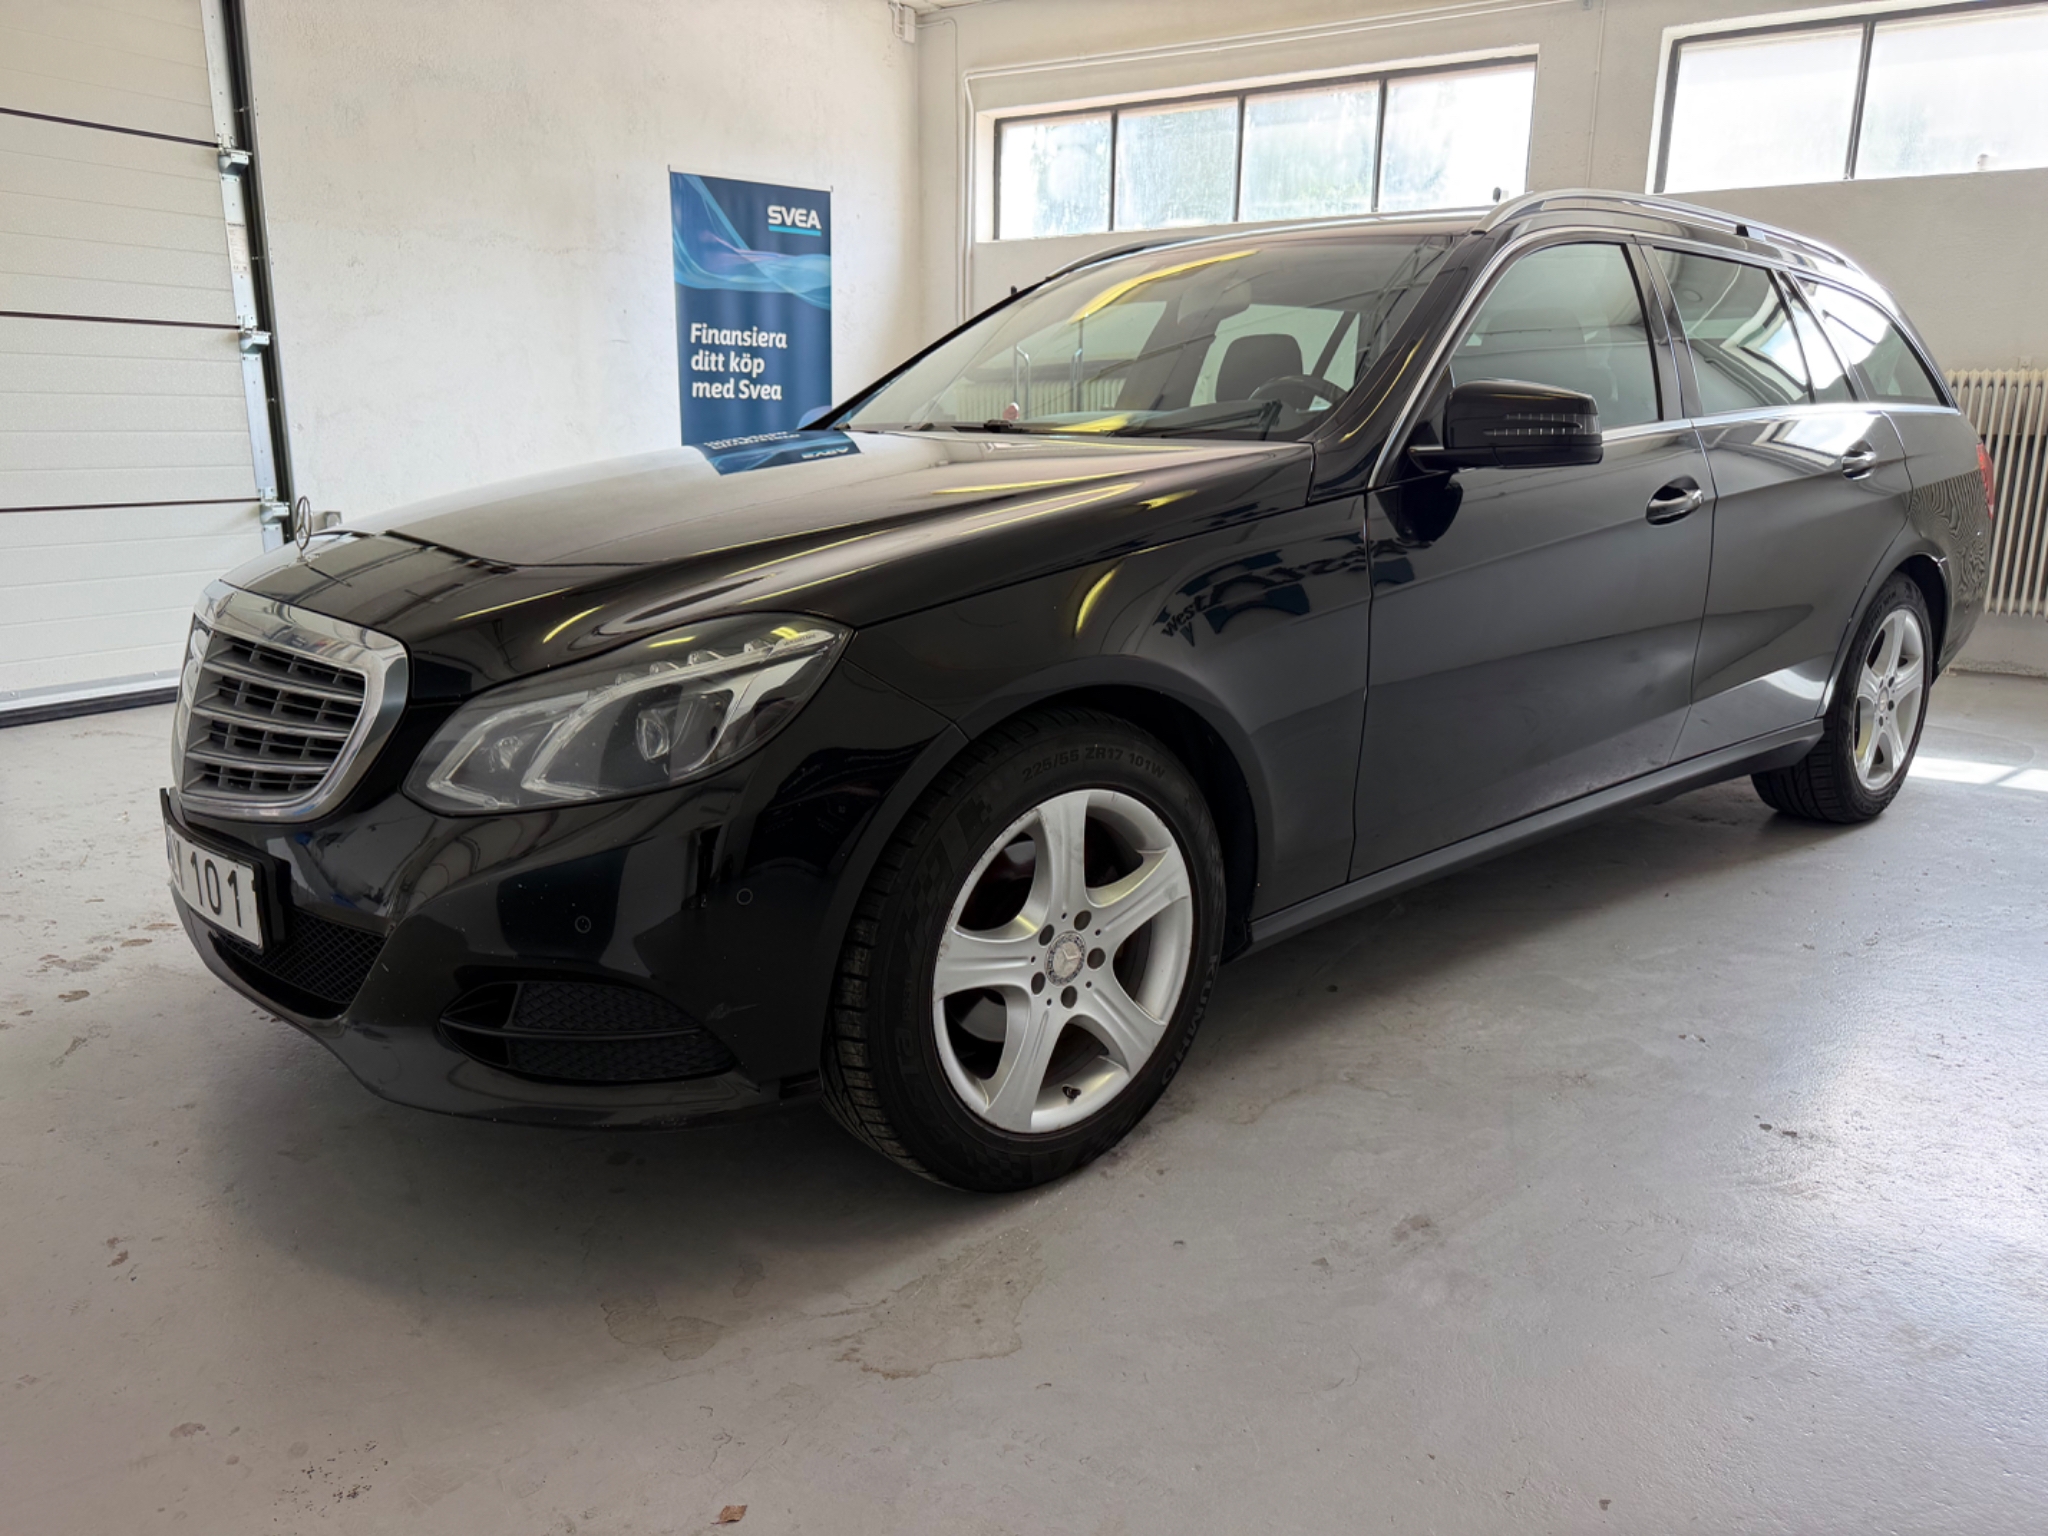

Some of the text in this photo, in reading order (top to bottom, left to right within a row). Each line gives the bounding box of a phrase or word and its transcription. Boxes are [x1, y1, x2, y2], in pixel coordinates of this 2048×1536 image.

[767, 204, 822, 230] SVEA
[690, 323, 788, 349] Finansiera
[691, 350, 765, 378] ditt köp
[692, 378, 783, 401] med Svea
[1021, 746, 1167, 782] 225/55 ZR17 101W
[190, 850, 242, 929] 101
[1161, 954, 1219, 1087] KUMHO
